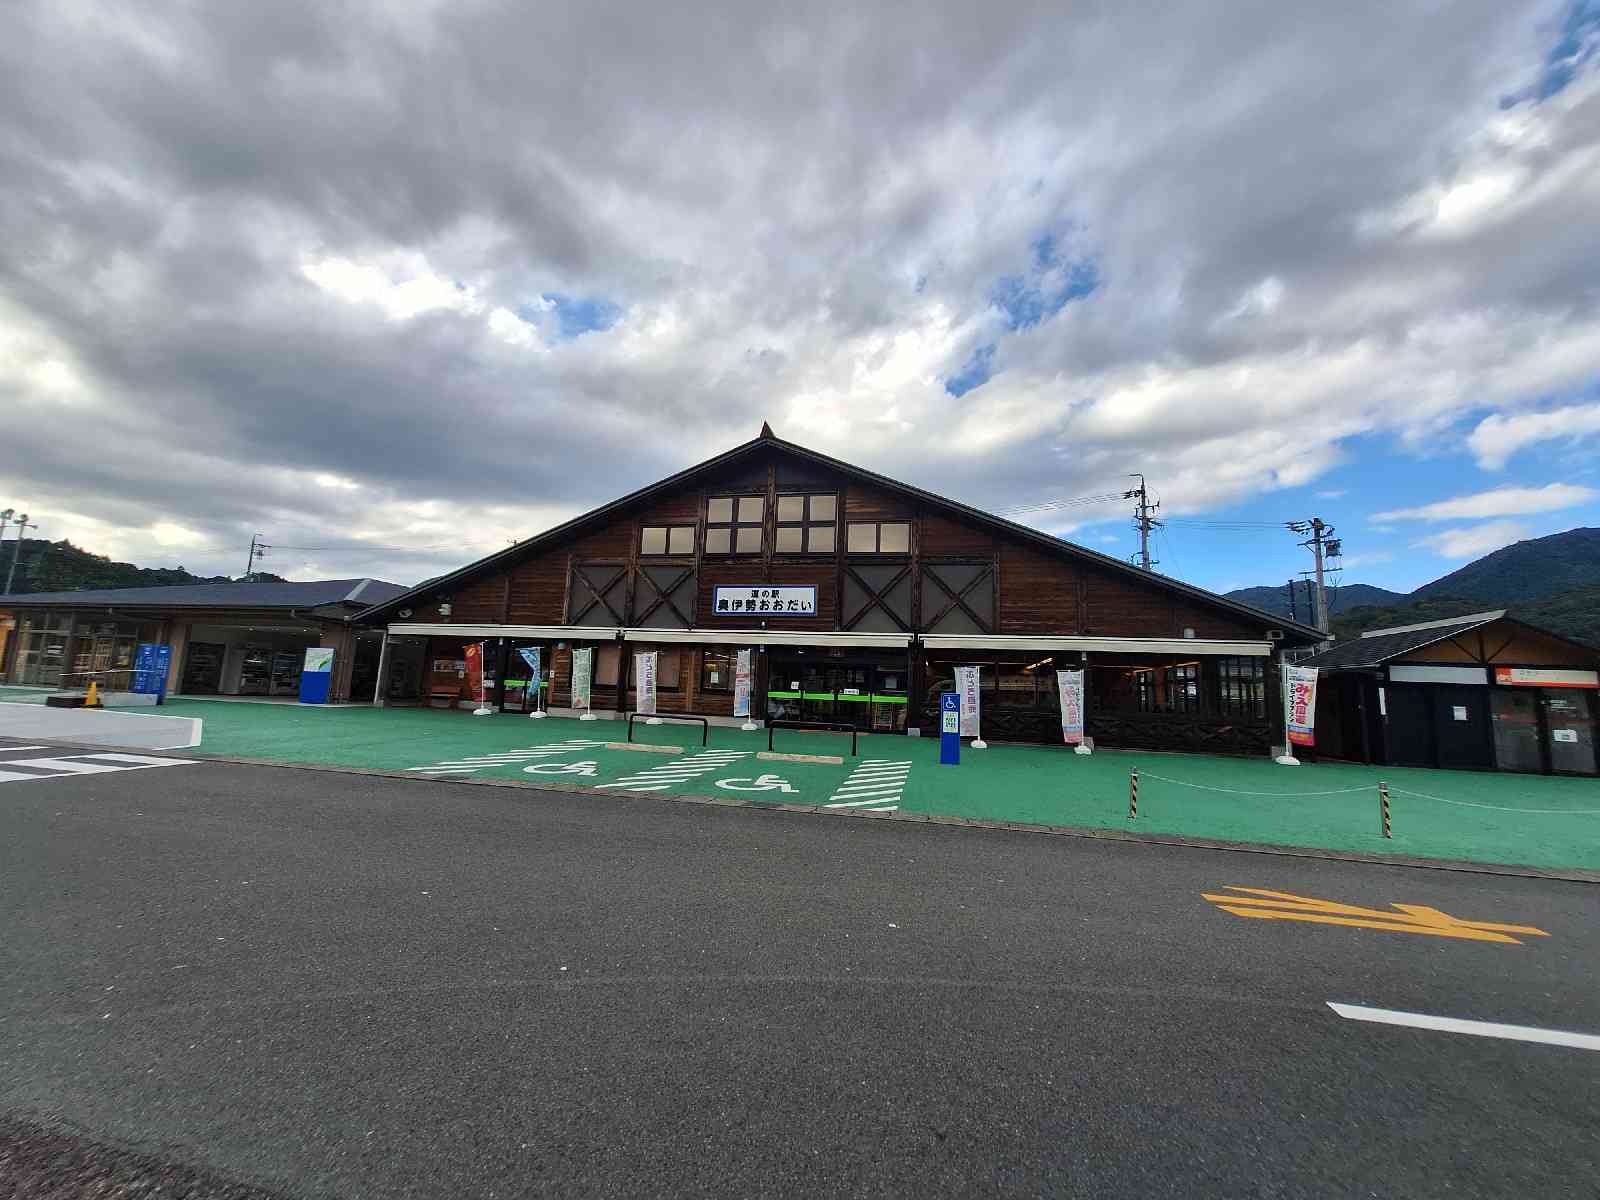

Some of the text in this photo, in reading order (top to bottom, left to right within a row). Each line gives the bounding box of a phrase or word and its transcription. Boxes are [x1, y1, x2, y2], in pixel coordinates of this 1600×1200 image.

[751, 590, 780, 598] 道の駅
[717, 600, 812, 611] 奥伊勢おおだい
